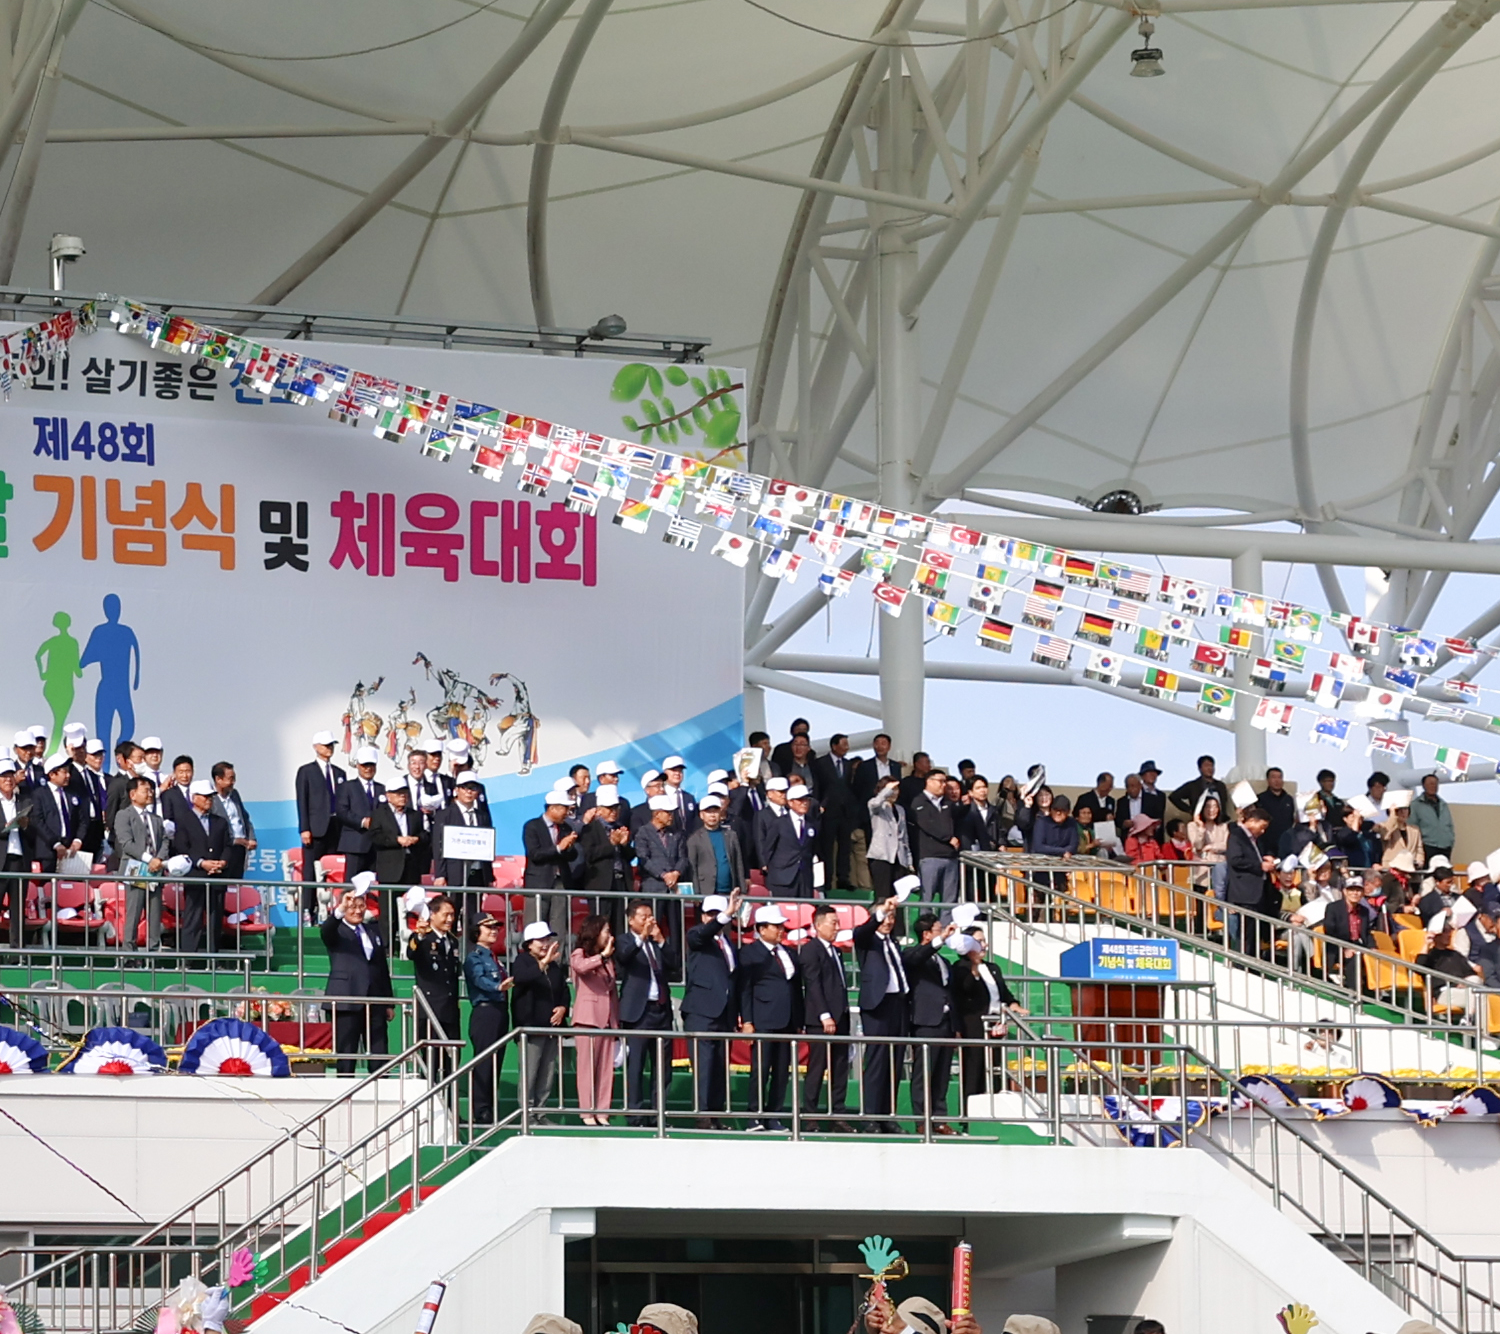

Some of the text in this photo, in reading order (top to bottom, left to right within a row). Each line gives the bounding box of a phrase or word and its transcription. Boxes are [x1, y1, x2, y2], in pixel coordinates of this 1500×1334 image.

[81, 356, 218, 402] 살기좋은
[33, 415, 155, 466] 제48회
[32, 474, 235, 571] 기념식
[259, 500, 310, 572] 및
[329, 491, 597, 587] 체육대회
